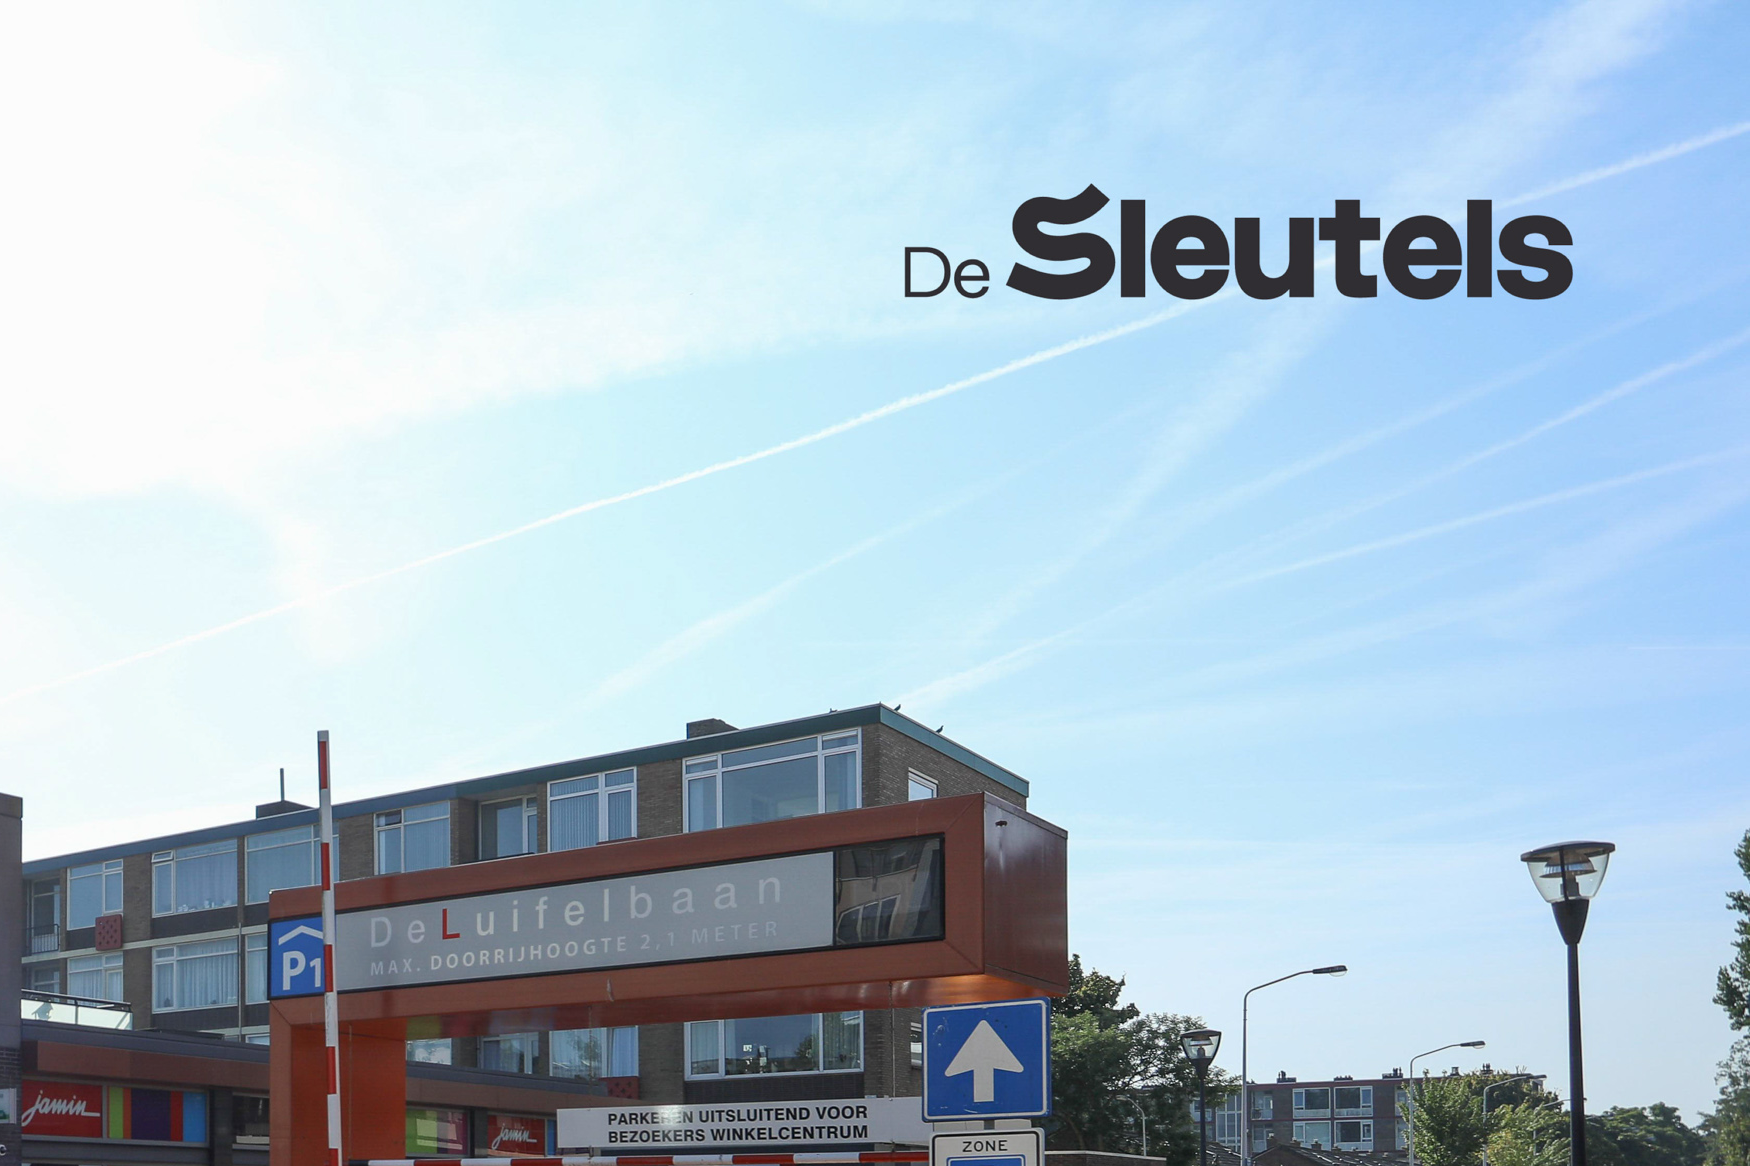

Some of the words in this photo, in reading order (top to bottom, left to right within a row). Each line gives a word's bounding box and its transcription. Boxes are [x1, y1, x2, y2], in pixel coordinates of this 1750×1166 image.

[370, 957, 421, 977] MAX.
[430, 935, 628, 971] DOORRIJHOOGTE
[639, 930, 676, 952] 2,1
[691, 920, 779, 945] METER
[282, 950, 322, 991] P1
[21, 1089, 101, 1127] jamin
[607, 1110, 694, 1127] PARKEREN
[698, 1106, 811, 1124] UITSLUITEND
[815, 1104, 868, 1121] VOOR
[491, 1122, 538, 1150] jamin
[608, 1127, 706, 1145] BEZOEKERS
[710, 1124, 869, 1142] WINKELCENTRUM
[962, 1139, 1008, 1153] ZONE
